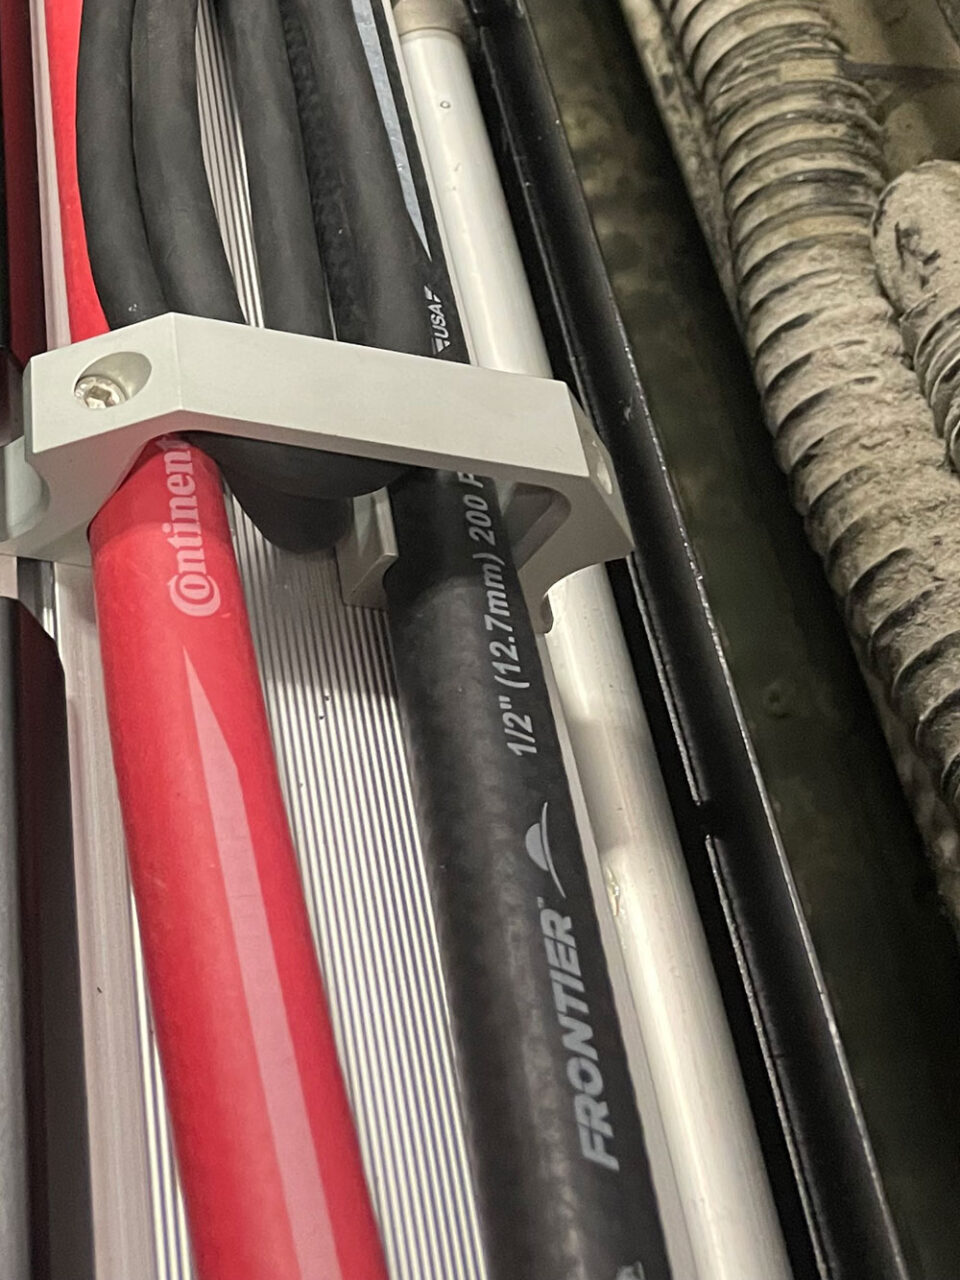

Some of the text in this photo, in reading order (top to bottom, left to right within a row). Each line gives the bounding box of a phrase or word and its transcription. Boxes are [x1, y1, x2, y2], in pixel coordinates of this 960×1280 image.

[427, 303, 450, 340] USA
[155, 434, 222, 618] Continent
[462, 493, 497, 547] 200
[472, 551, 531, 690] (12.7mm)
[498, 694, 539, 757] 1/2"
[540, 907, 621, 1172] FRONTIER
